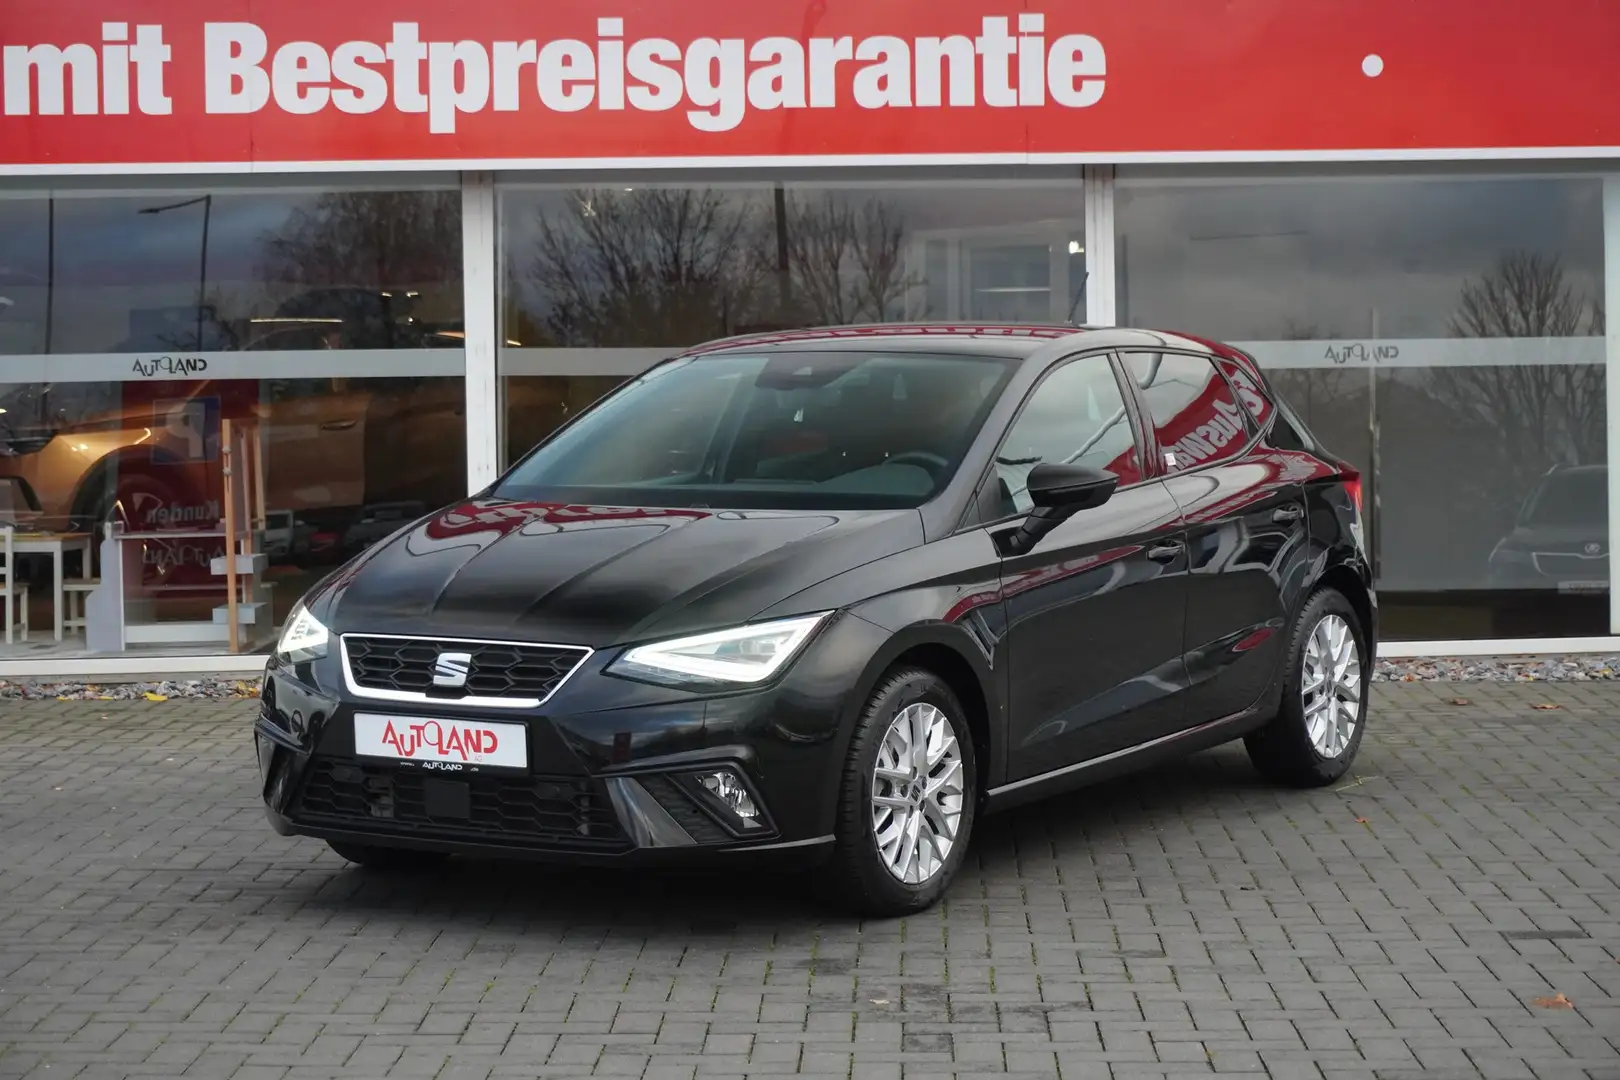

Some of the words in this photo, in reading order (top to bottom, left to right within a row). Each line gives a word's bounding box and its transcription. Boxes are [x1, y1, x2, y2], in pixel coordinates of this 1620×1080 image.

[3, 21, 172, 115] mit
[205, 13, 1107, 135] Bestpreisgarantie
[382, 719, 498, 761] AUTOLAND
